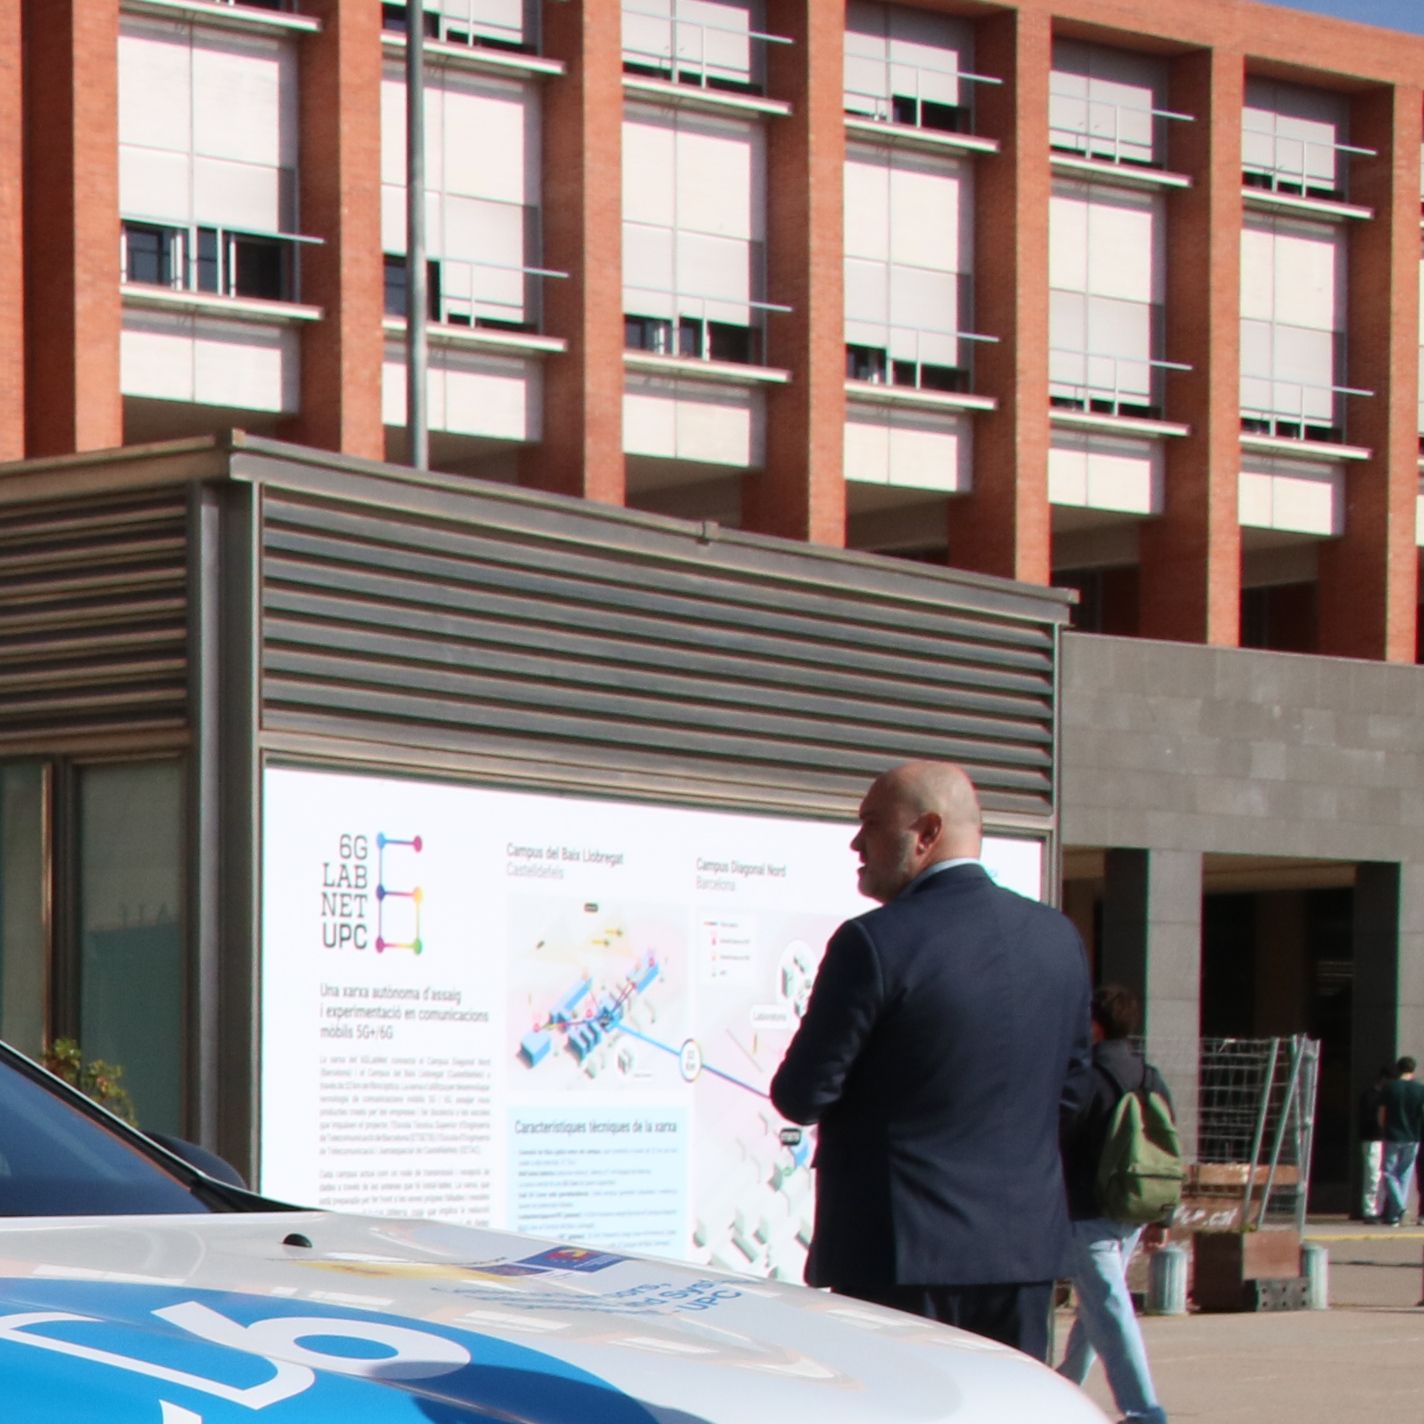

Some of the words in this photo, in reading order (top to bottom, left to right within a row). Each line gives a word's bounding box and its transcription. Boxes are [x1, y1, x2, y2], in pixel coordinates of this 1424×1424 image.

[339, 834, 368, 860] 6G
[506, 842, 543, 859] Campus
[545, 846, 560, 859] del
[562, 847, 580, 861] Baix
[583, 849, 624, 867] Llobregat
[323, 862, 368, 889] LAB
[696, 857, 729, 875] Campus
[731, 860, 765, 876] Diagonal
[767, 863, 786, 878] Nord
[321, 891, 368, 918] NET
[322, 922, 368, 950] UPC
[320, 983, 339, 997] Una
[343, 986, 369, 998] xarxa
[404, 1008, 416, 1019] en
[418, 1008, 489, 1023] comunicacions
[632, 1120, 643, 1133] de
[645, 1120, 653, 1133] la
[655, 1122, 677, 1133] xarxa
